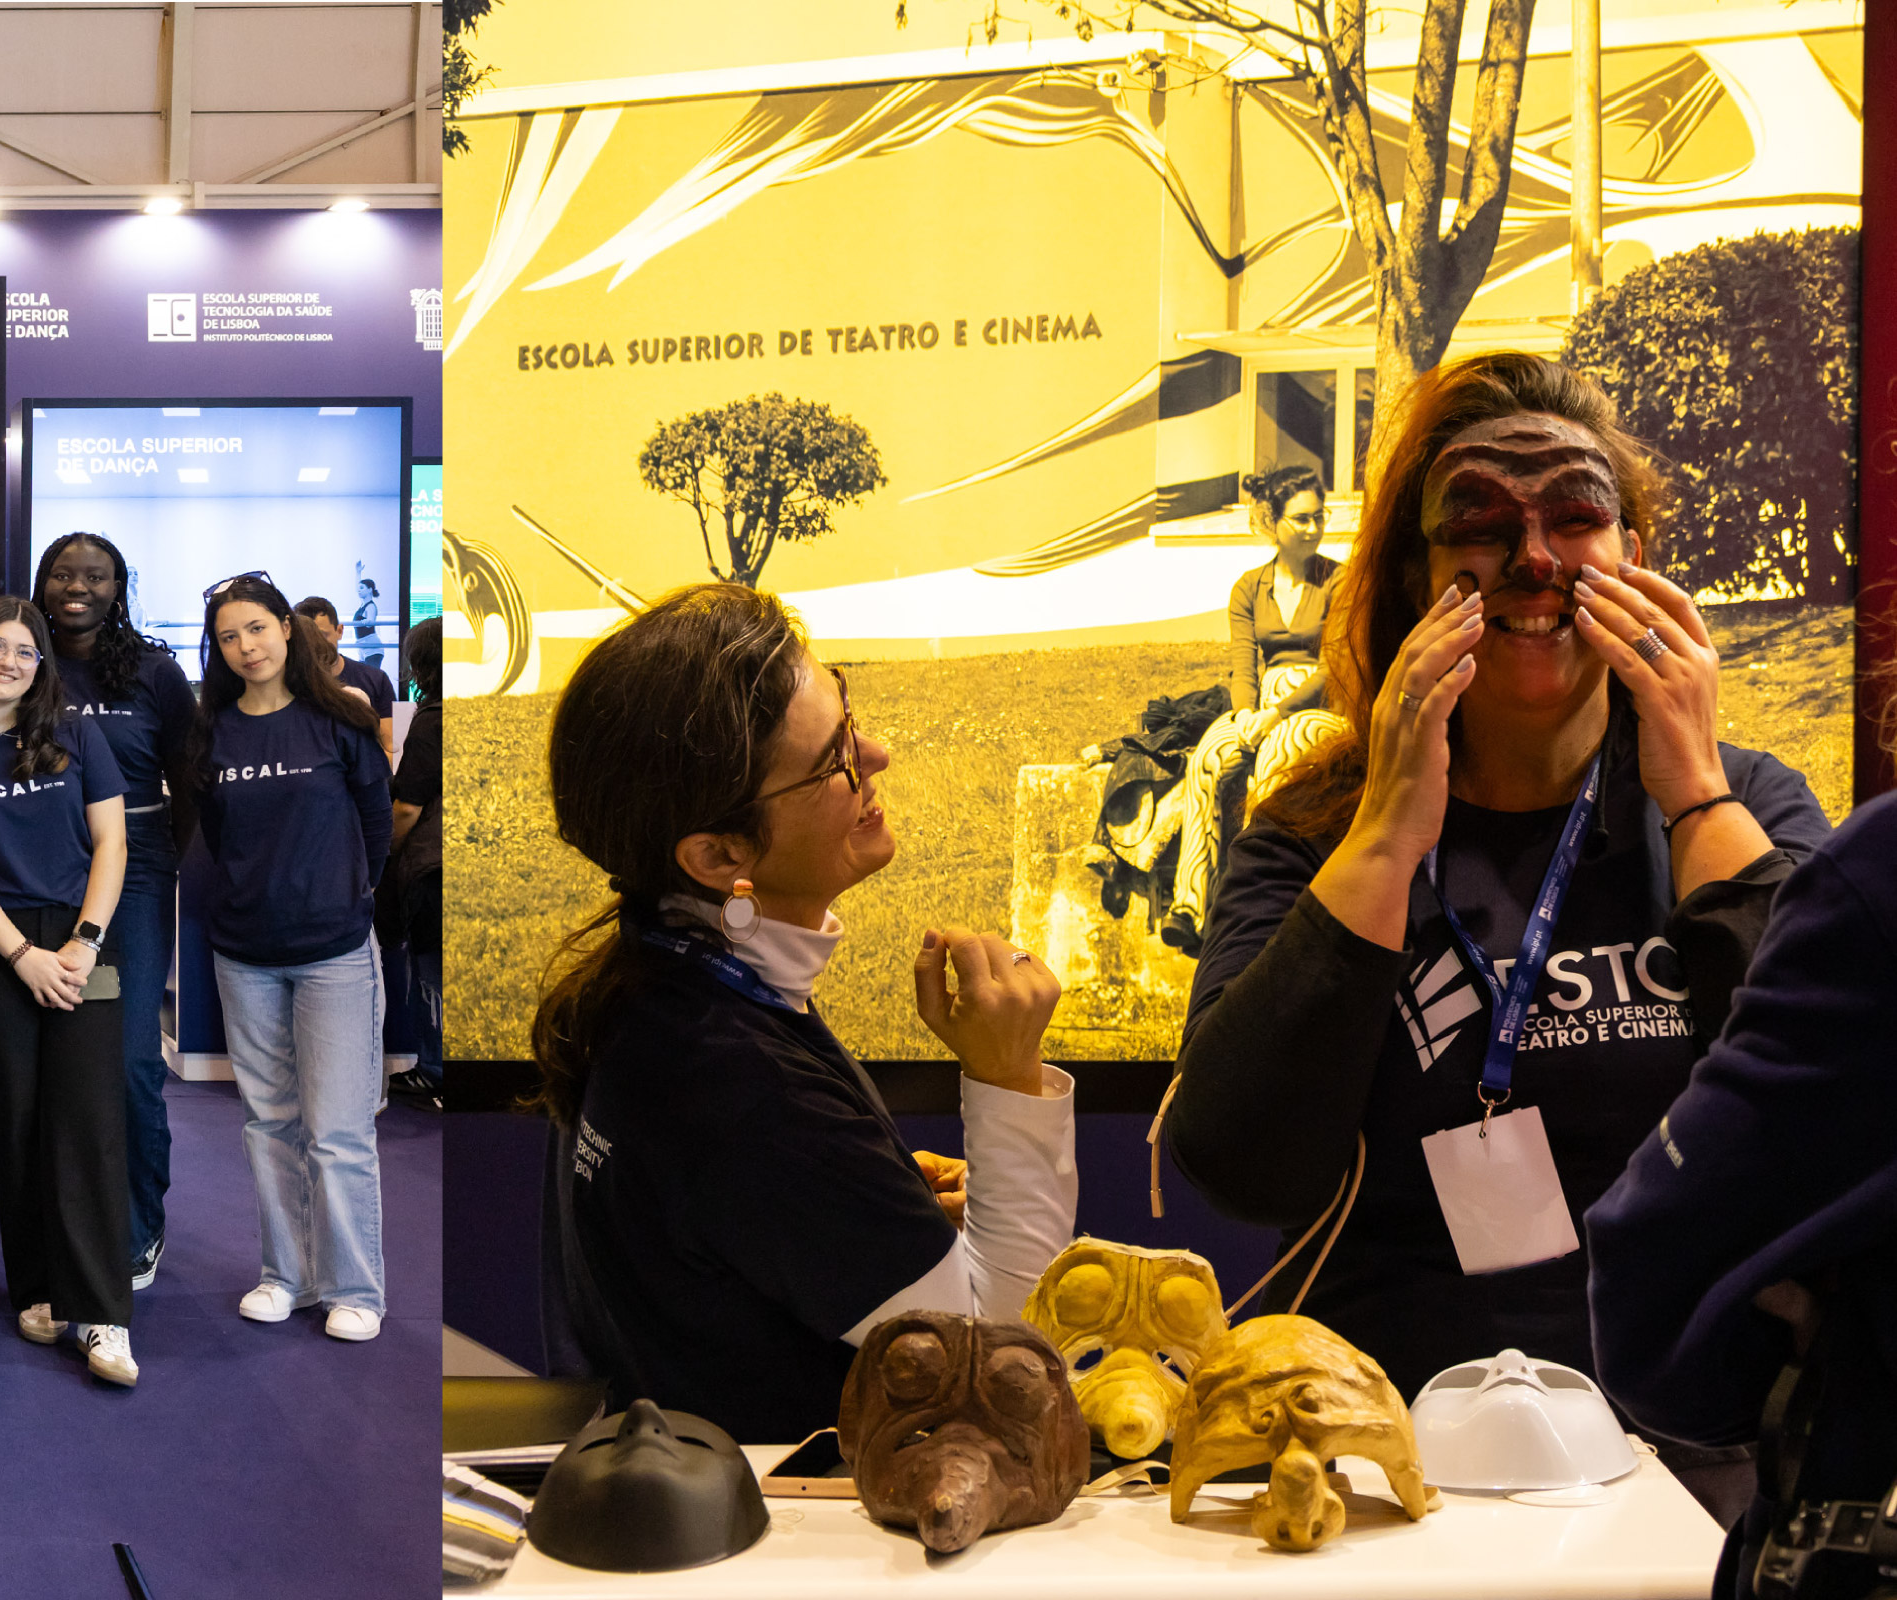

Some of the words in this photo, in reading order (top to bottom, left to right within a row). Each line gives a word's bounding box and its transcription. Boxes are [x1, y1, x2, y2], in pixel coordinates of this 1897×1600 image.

[203, 294, 245, 304] ESCOLA
[248, 293, 302, 304] SUPERIOR
[304, 294, 319, 304] DE
[203, 306, 274, 317] TECNOLOGIA
[277, 306, 293, 317] DA
[295, 304, 332, 317] SAÚDE
[15, 325, 69, 340] DANÇA
[203, 319, 218, 329] DE
[221, 319, 260, 329] LISBOA
[203, 334, 242, 342] INSTITUTO
[518, 342, 615, 371] ESCOLA
[628, 332, 765, 364] SUPERIOR
[779, 329, 813, 357] DE
[827, 322, 939, 353] TEATRO
[954, 319, 967, 346] E
[983, 312, 1103, 345] CINEMA
[58, 438, 136, 454] ESCOLA
[142, 437, 243, 454] SUPERIOR
[58, 459, 83, 473] DE
[90, 458, 158, 477] DANÇA
[218, 762, 287, 783] ISCAL
[1527, 930, 1543, 965] www.ipl.pt
[1586, 1004, 1680, 1024] SUPERIOR
[1597, 1024, 1610, 1042] E
